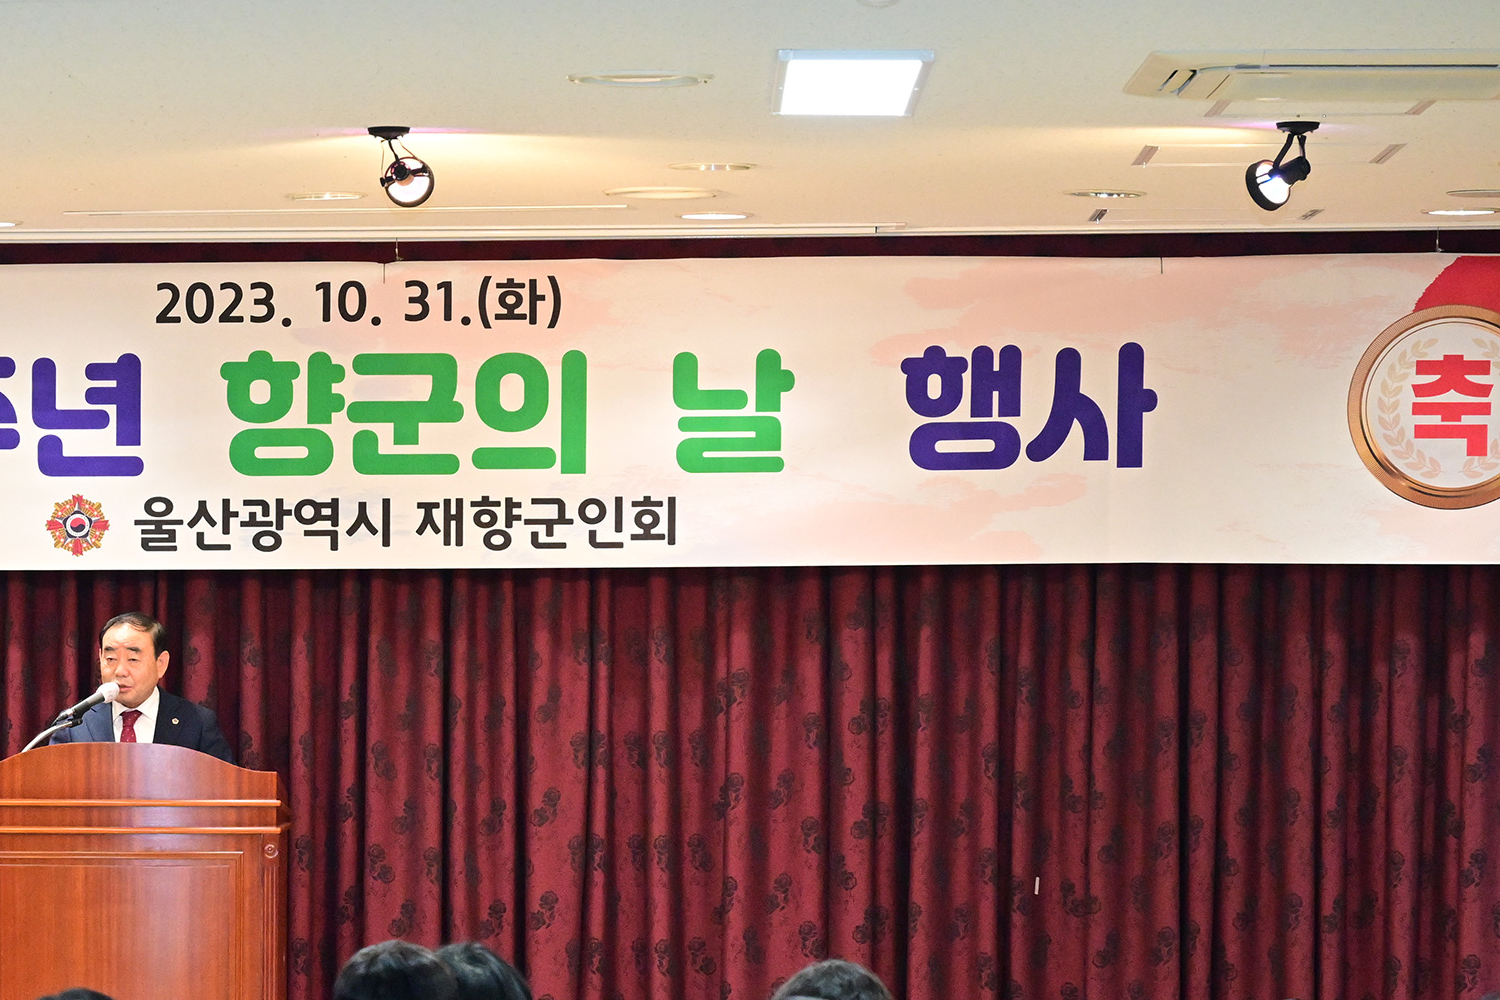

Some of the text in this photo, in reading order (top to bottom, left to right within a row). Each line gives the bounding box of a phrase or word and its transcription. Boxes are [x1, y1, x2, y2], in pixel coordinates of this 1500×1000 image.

[156, 276, 561, 328] 2023. 10. 31.(화)
[221, 351, 586, 476] 향군의
[674, 349, 794, 473] 날
[901, 342, 1157, 470] 행사
[1412, 355, 1493, 456] 축
[135, 496, 675, 552] 울산광역시 재향군인회
